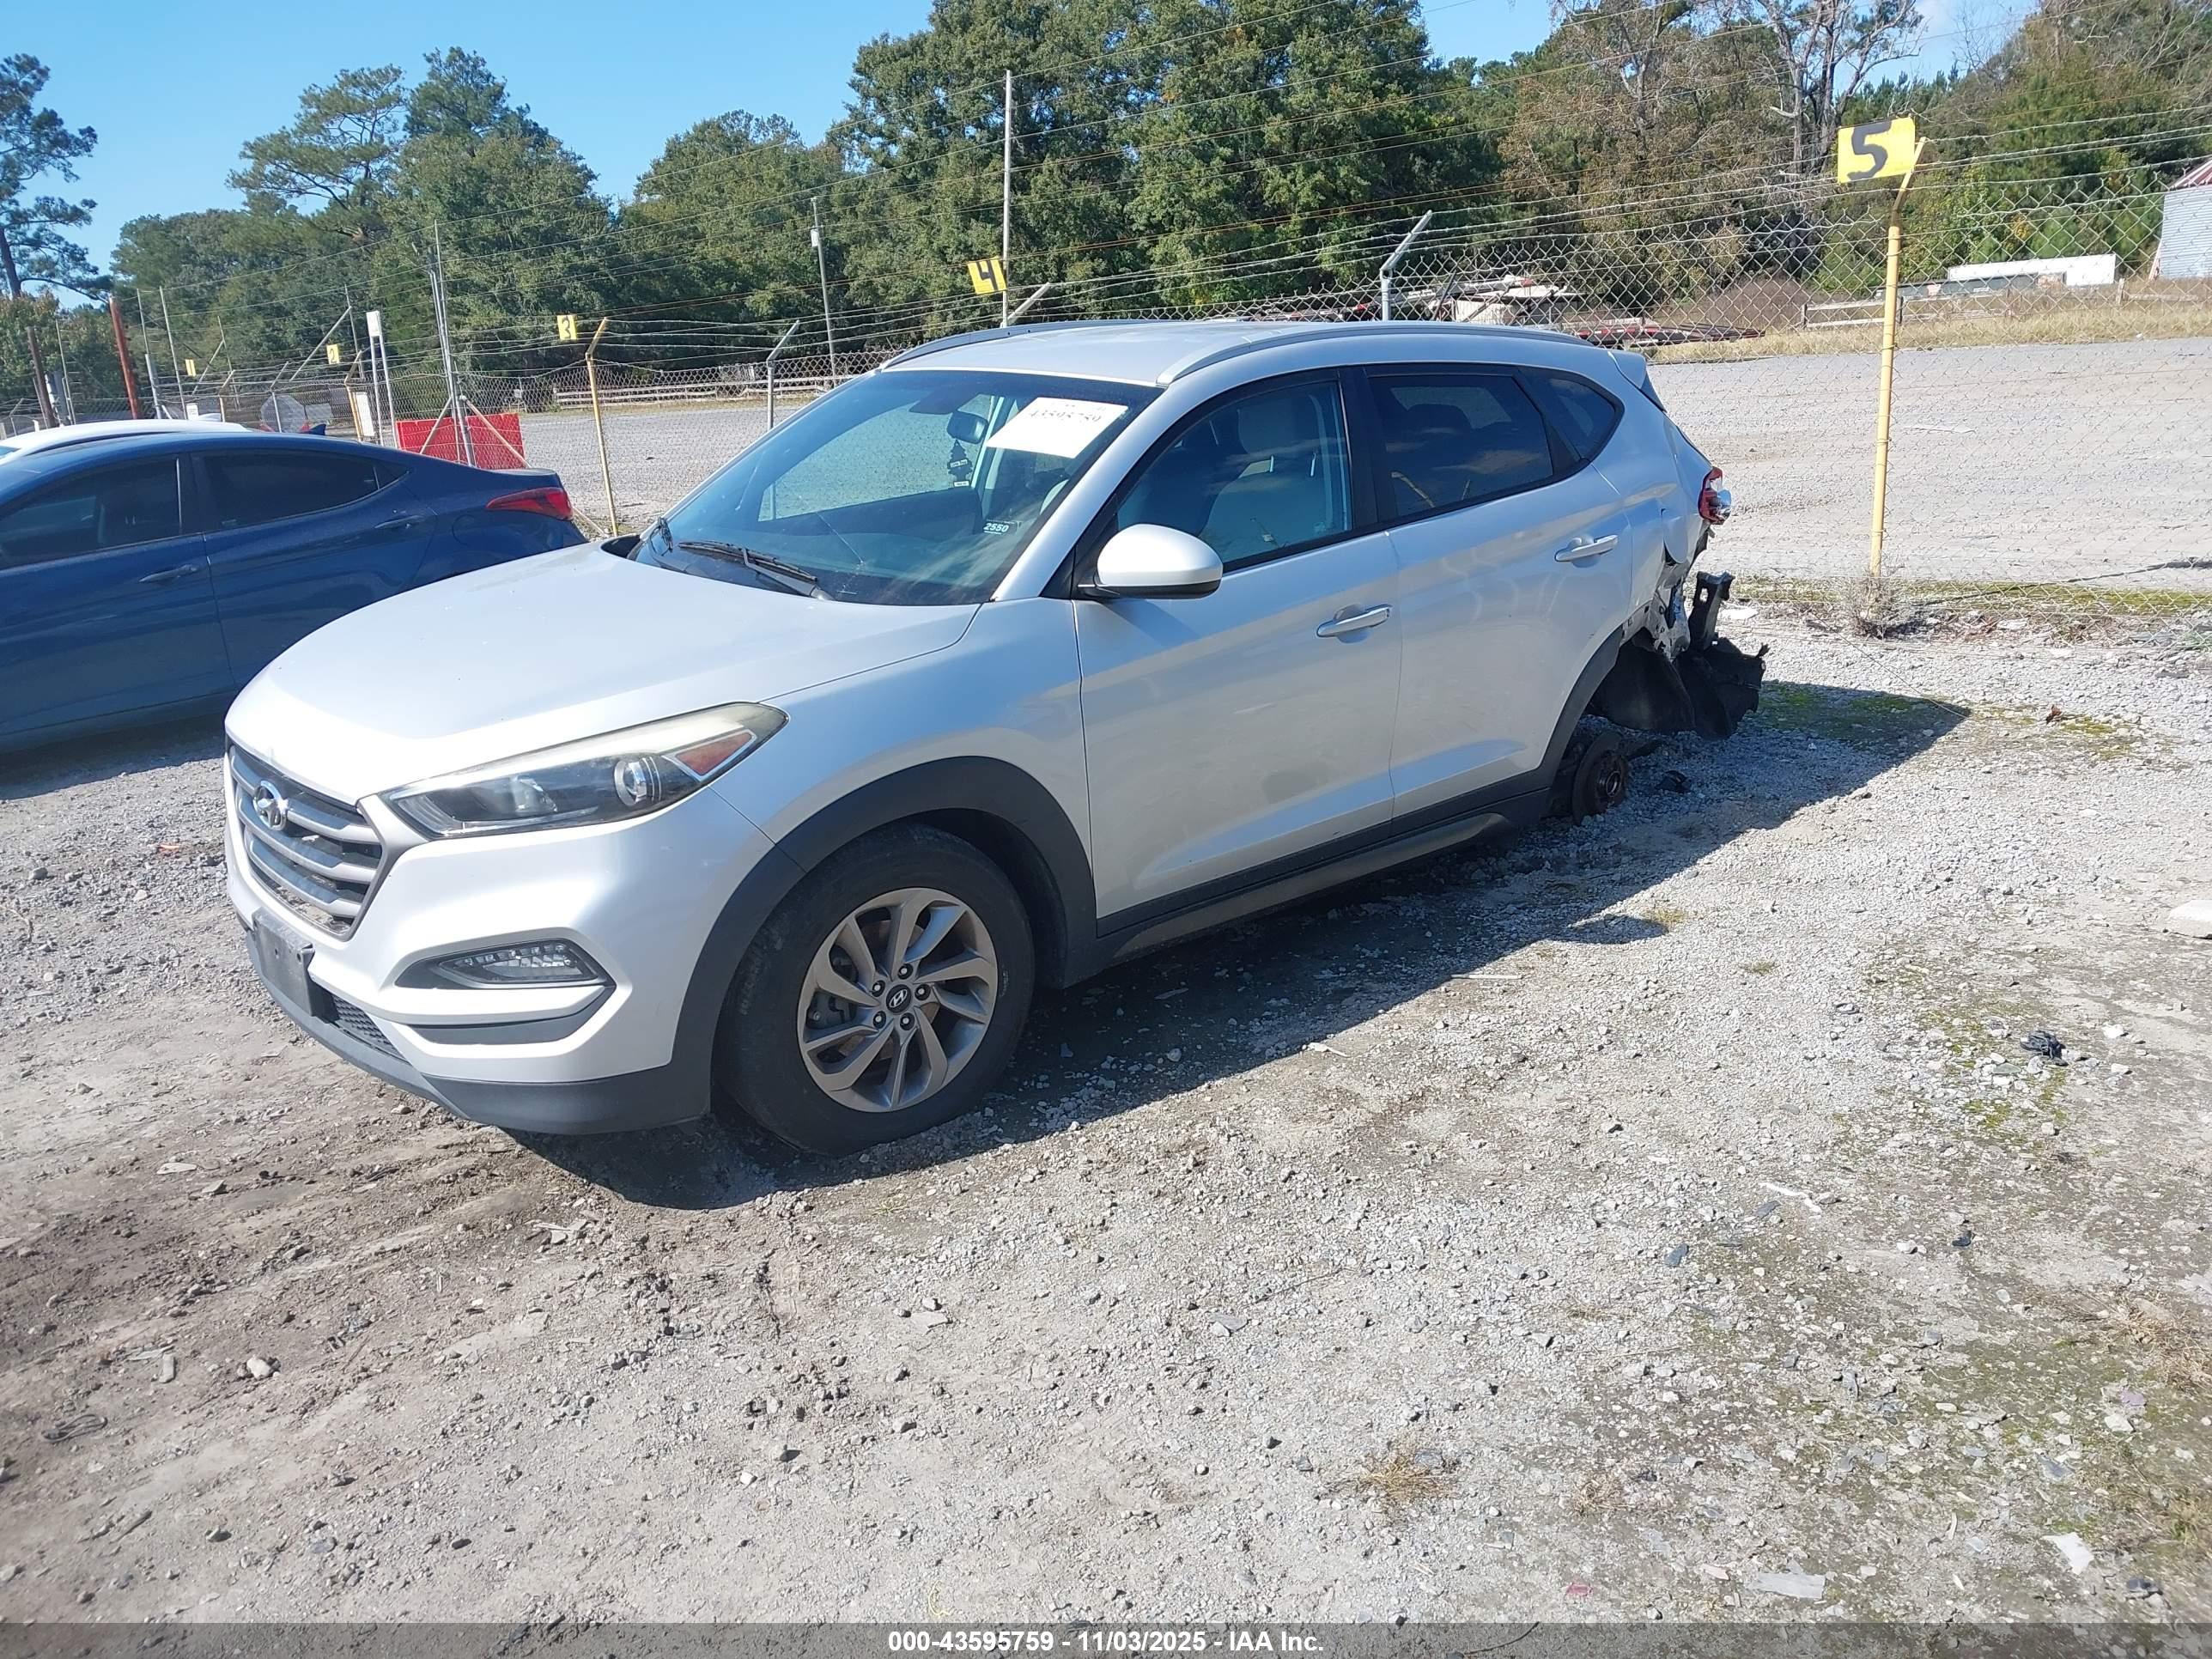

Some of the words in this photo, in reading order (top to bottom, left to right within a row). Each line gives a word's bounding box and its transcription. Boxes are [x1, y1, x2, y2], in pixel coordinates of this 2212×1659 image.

[1847, 120, 1892, 181] 5
[975, 260, 999, 291] 4
[562, 315, 571, 339] 3
[330, 348, 337, 363] 2
[983, 522, 1010, 532] 2550
